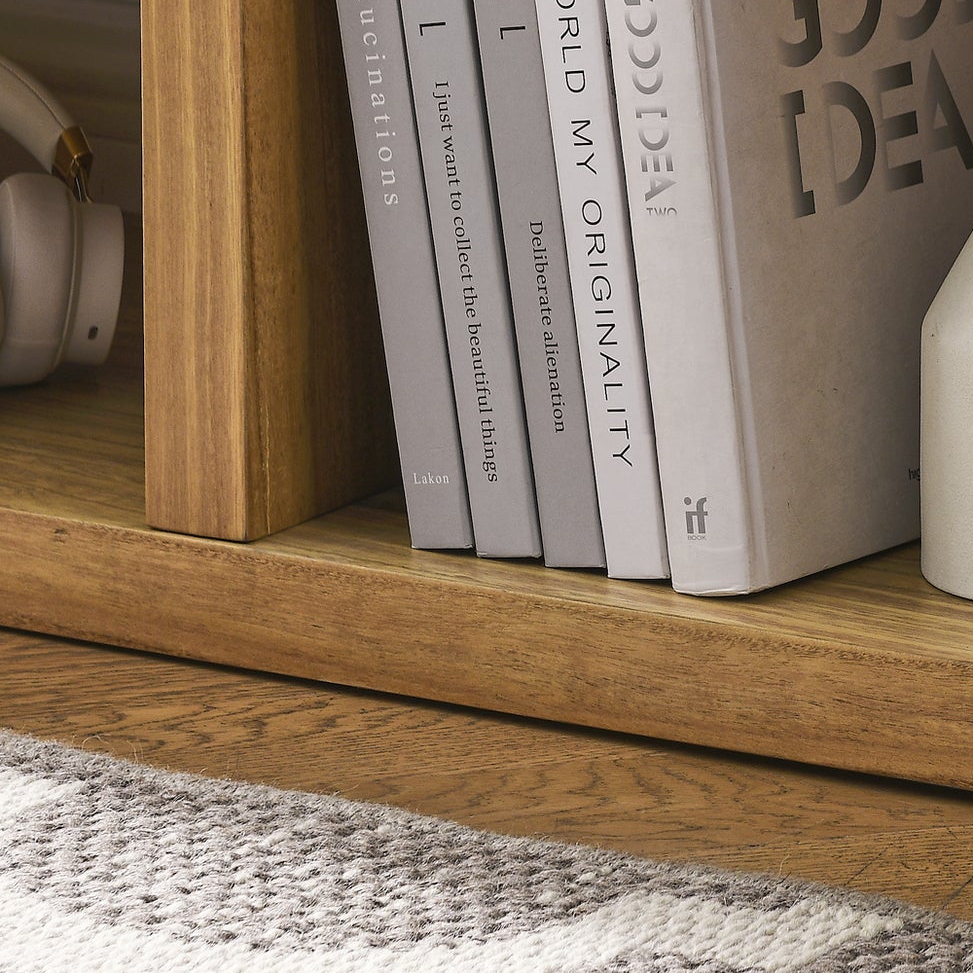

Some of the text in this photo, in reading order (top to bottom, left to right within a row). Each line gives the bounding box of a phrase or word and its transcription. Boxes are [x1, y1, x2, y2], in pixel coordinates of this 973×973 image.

[571, 119, 598, 175] MY
[635, 106, 677, 202] IDEA
[433, 81, 498, 483] I just want to collect the beautiful things
[529, 221, 566, 433] Deliberate alienation
[581, 199, 634, 468] ORIGINALITY
[413, 472, 449, 484] Lakon
[683, 497, 708, 534] if
